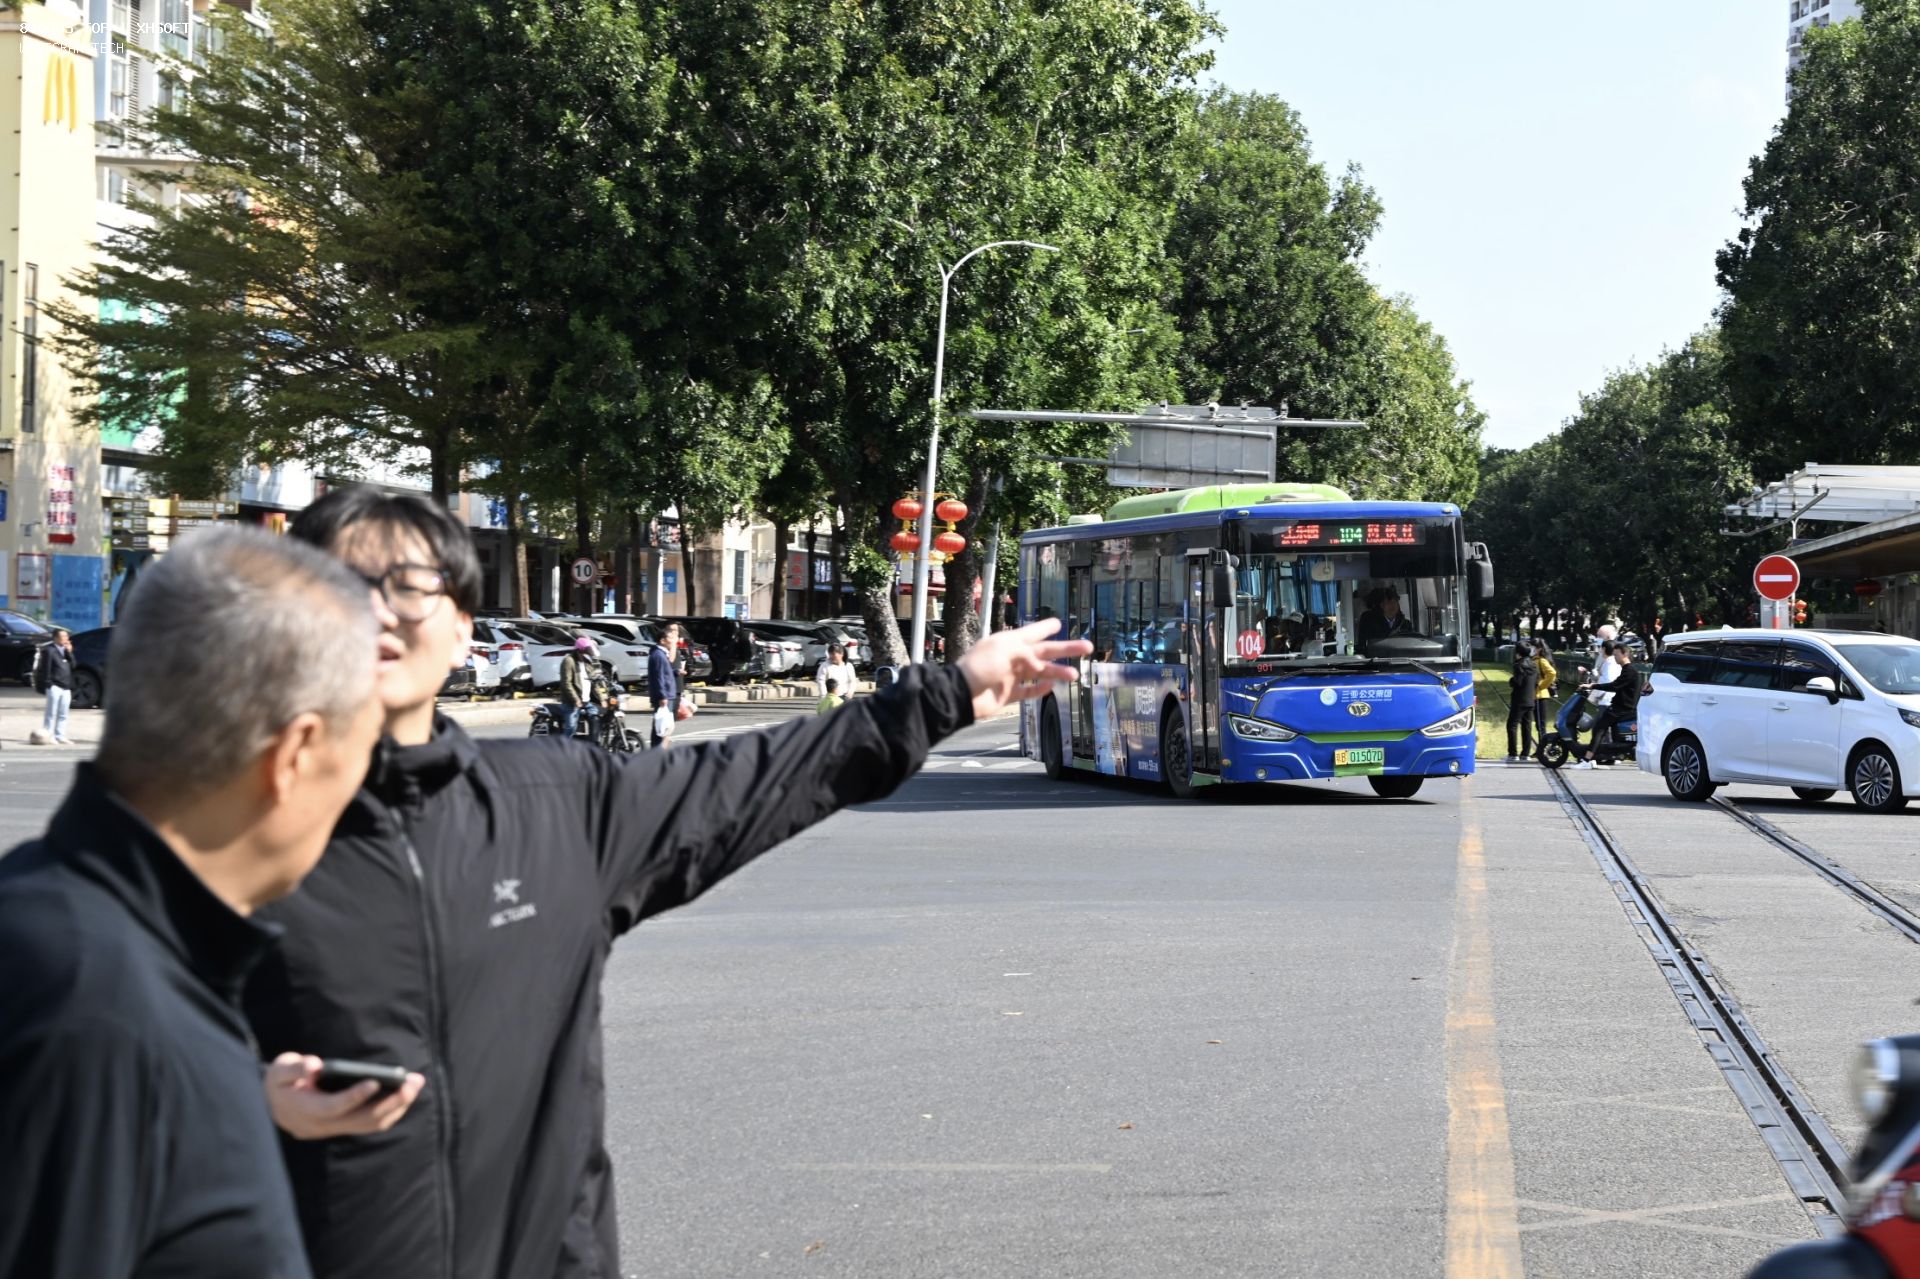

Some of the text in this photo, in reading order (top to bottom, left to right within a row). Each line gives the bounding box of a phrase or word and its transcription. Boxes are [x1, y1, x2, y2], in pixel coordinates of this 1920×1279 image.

[575, 563, 592, 578] 10
[1238, 634, 1262, 656] 104
[1257, 663, 1273, 672] 901
